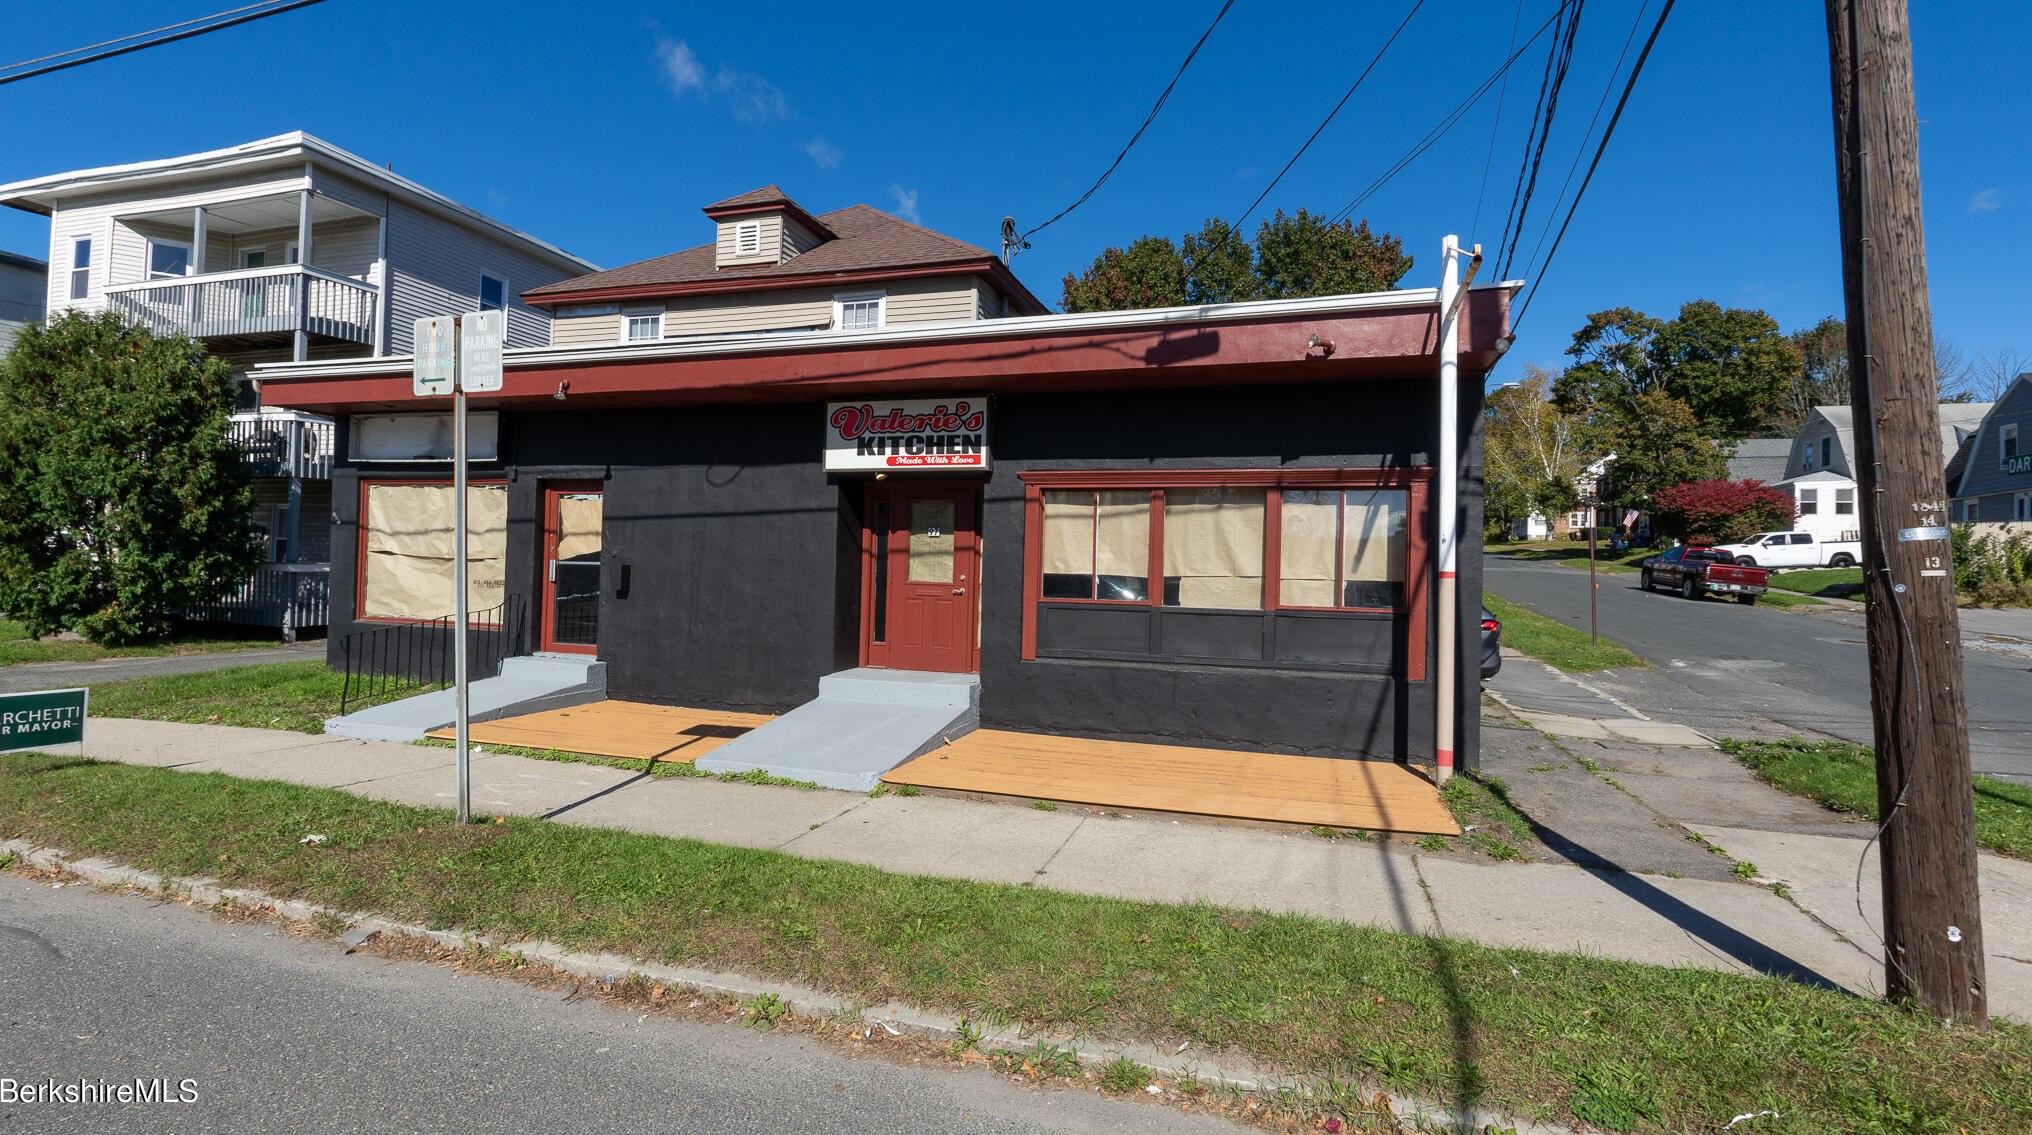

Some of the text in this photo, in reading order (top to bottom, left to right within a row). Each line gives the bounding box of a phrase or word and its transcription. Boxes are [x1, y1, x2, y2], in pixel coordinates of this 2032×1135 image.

[476, 316, 488, 332] NO
[422, 341, 447, 353] HOUR
[464, 334, 499, 351] PARKING
[417, 357, 453, 369] PARKING
[473, 351, 490, 363] HERE
[831, 401, 984, 441] Valerie's
[857, 434, 982, 457] KITCHEN
[895, 455, 975, 465] Made With Love
[2009, 456, 2032, 473] DAR
[1924, 556, 1940, 569] 13
[0, 706, 80, 725] RCHETTI
[17, 720, 72, 734] MAYOR
